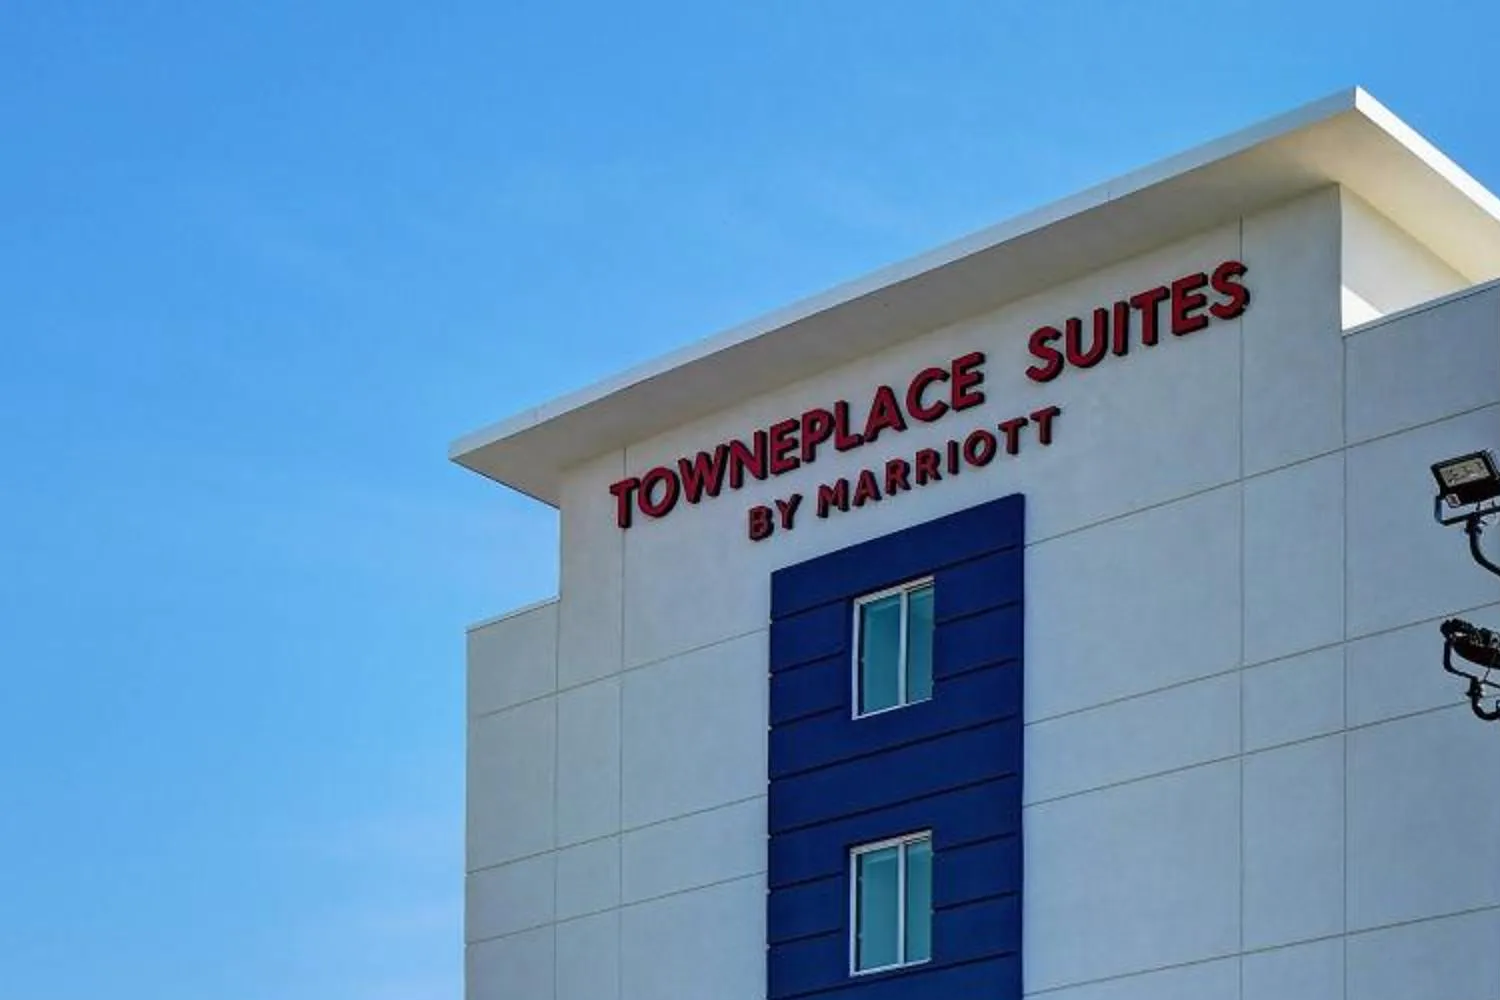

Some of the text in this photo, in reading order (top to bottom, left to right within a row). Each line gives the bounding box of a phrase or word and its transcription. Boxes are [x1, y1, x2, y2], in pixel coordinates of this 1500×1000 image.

[609, 260, 1251, 530] TOWNEPLACE SUITES
[748, 406, 1061, 541] BY MARRIOTT
